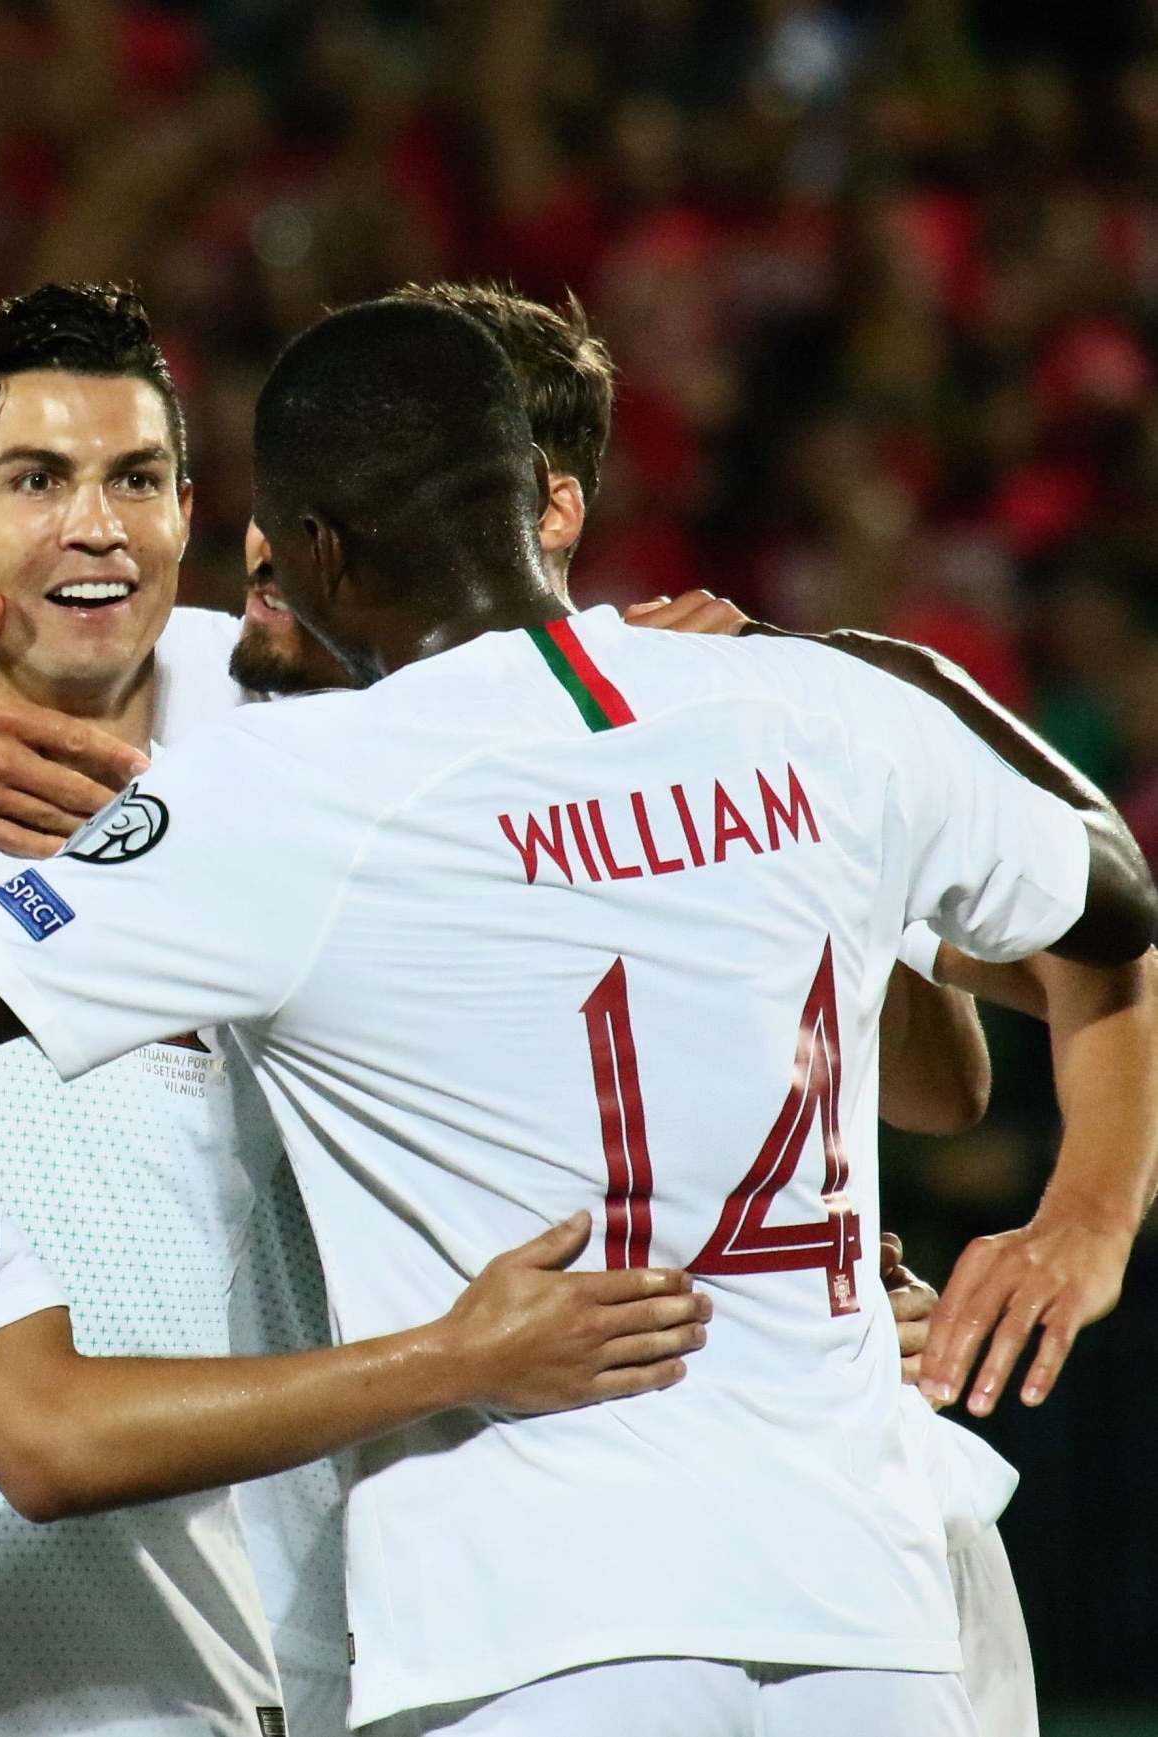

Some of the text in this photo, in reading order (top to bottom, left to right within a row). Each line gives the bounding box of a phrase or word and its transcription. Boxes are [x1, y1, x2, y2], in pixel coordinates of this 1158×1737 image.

[498, 761, 821, 885] WILLIAM
[153, 1065, 206, 1084] SETEMBRO
[164, 1080, 206, 1098] VILNIUS
[578, 932, 862, 1317] 14
